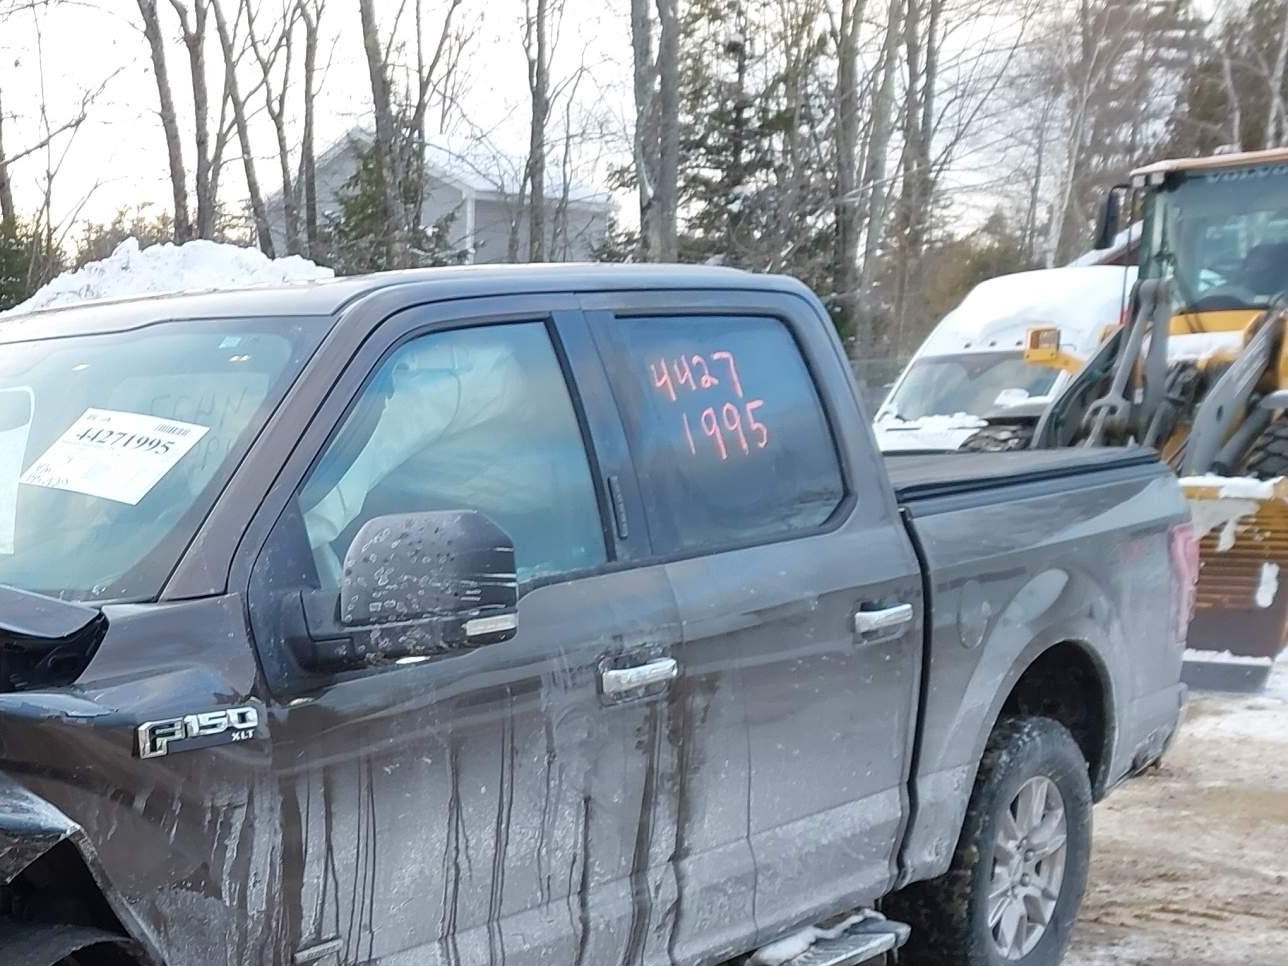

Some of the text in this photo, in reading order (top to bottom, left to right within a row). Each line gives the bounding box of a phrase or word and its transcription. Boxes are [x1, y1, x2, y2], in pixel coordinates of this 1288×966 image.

[650, 351, 744, 402] 4427
[75, 427, 175, 455] 44271995
[682, 399, 768, 460] 1995
[231, 730, 255, 742] XLT
